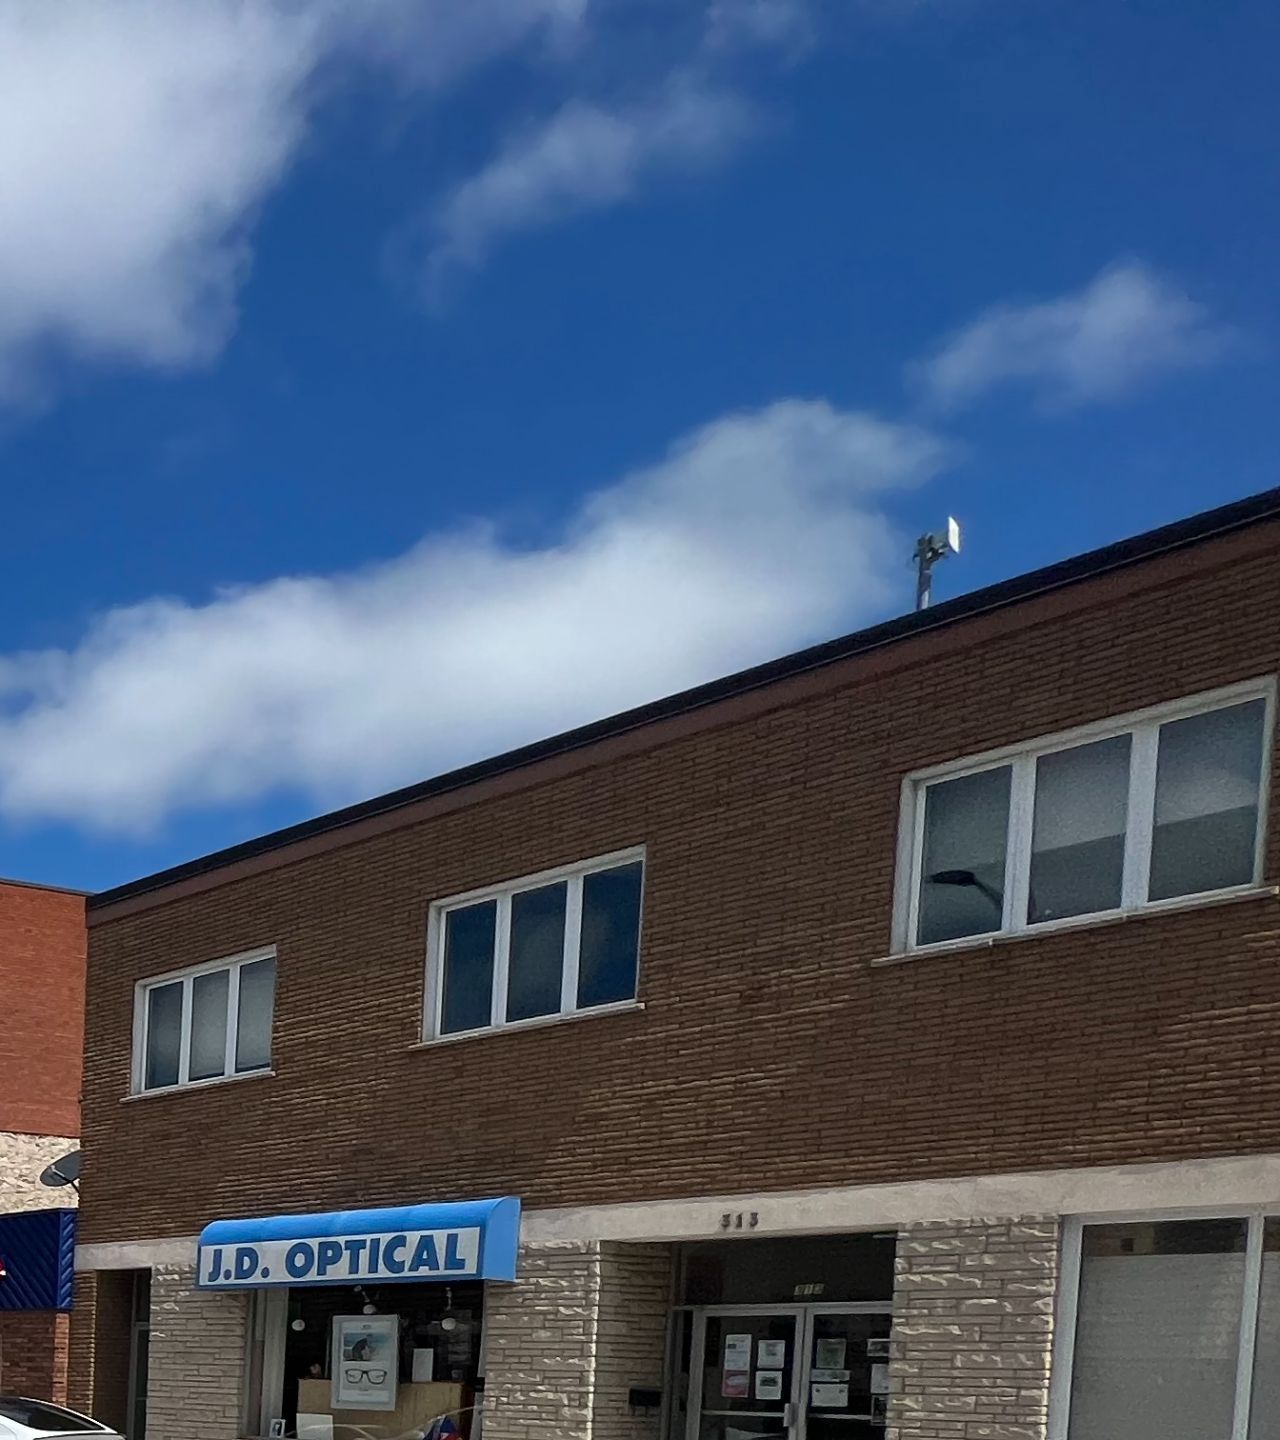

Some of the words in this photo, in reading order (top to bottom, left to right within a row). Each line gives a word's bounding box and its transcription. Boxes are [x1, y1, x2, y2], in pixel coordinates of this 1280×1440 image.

[721, 1211, 759, 1229] 313
[207, 1247, 270, 1282] J.D.
[285, 1233, 466, 1278] OPTICAL
